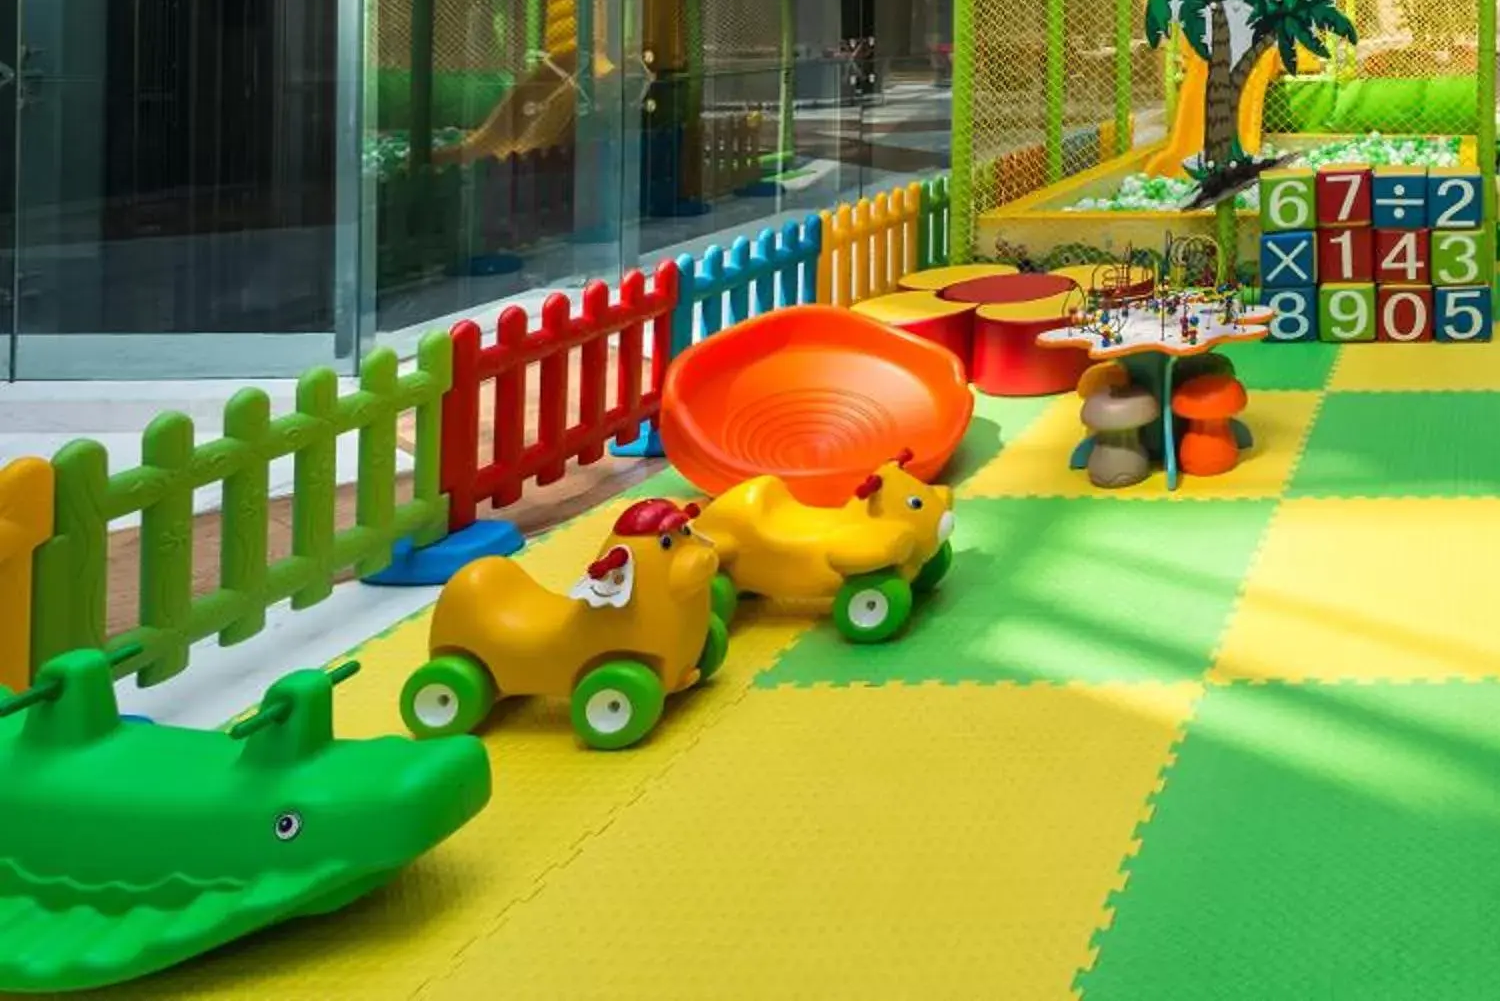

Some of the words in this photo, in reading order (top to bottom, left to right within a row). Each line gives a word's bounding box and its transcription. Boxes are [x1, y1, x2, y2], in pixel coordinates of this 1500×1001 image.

[1268, 180, 1309, 228] 6
[1325, 174, 1362, 221] 7
[1436, 178, 1476, 227] 2
[1330, 230, 1353, 279] 1
[1381, 232, 1425, 280] 4
[1438, 234, 1479, 283] 3
[1268, 291, 1310, 340] 8
[1328, 290, 1368, 339] 9
[1383, 292, 1427, 341] 0
[1443, 290, 1484, 339] 5
